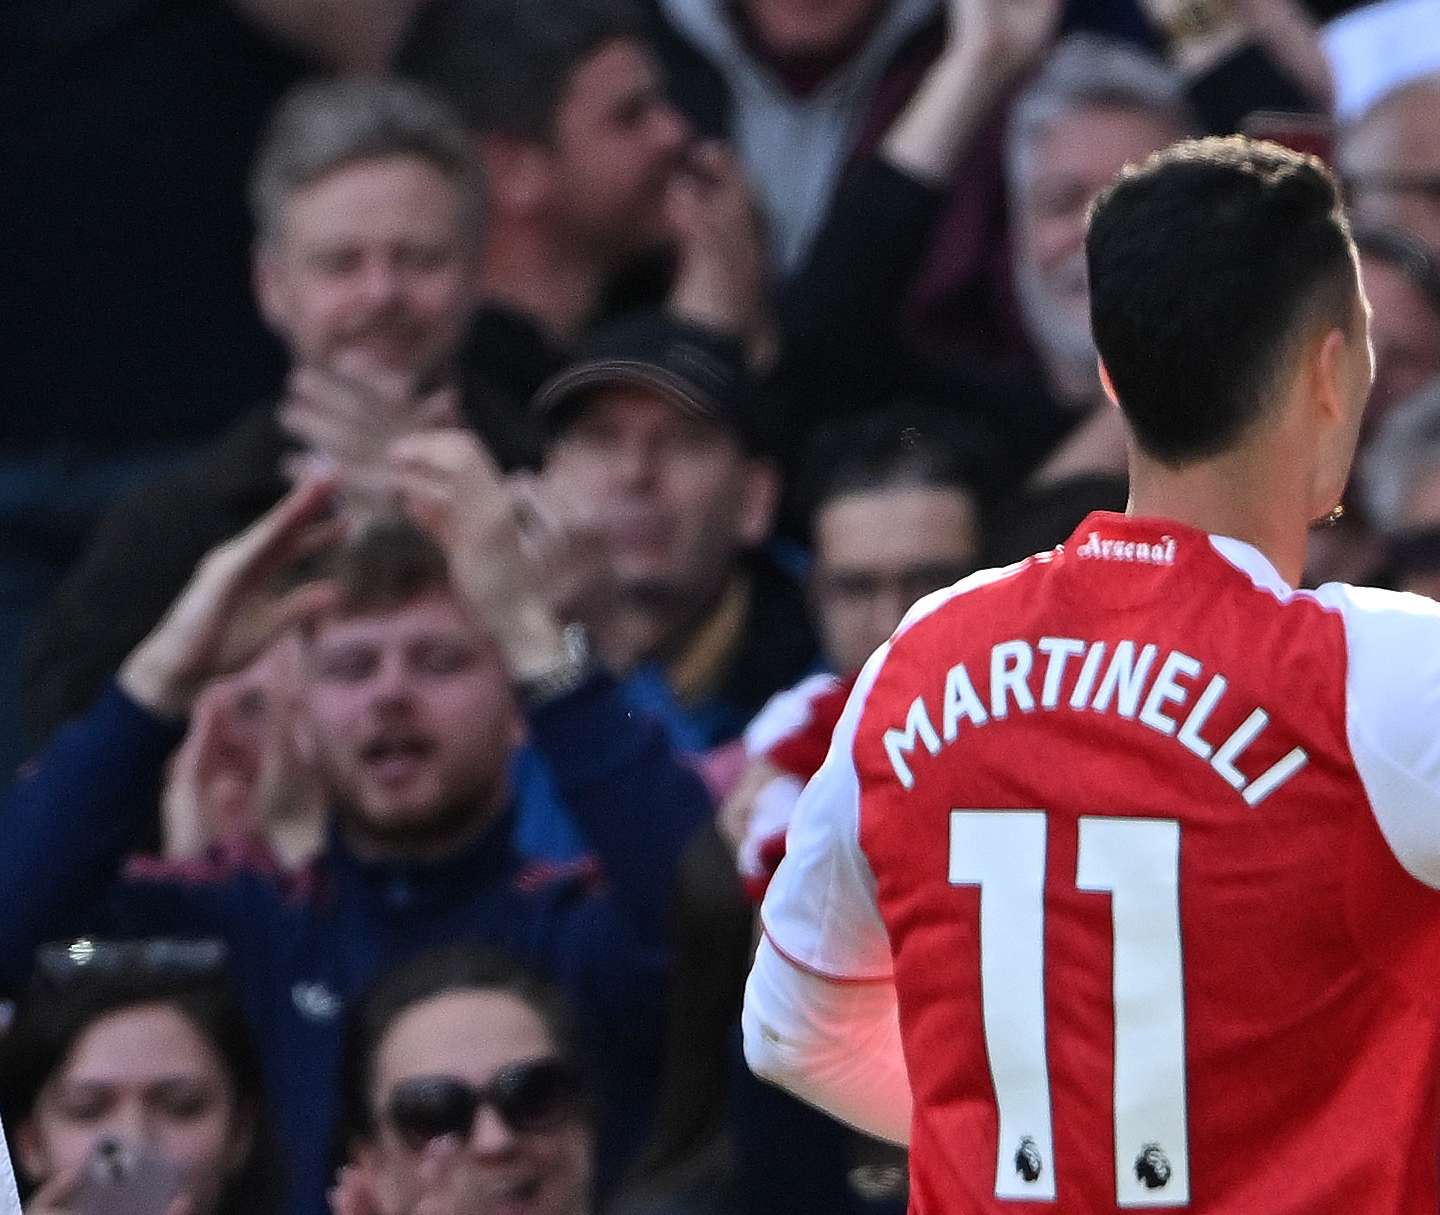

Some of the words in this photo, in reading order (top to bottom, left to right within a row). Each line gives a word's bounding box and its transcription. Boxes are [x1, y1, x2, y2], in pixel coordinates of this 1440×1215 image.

[1077, 531, 1177, 567] Arsenal
[882, 636, 1311, 807] MARTINELLI
[948, 808, 1191, 1209] 11
